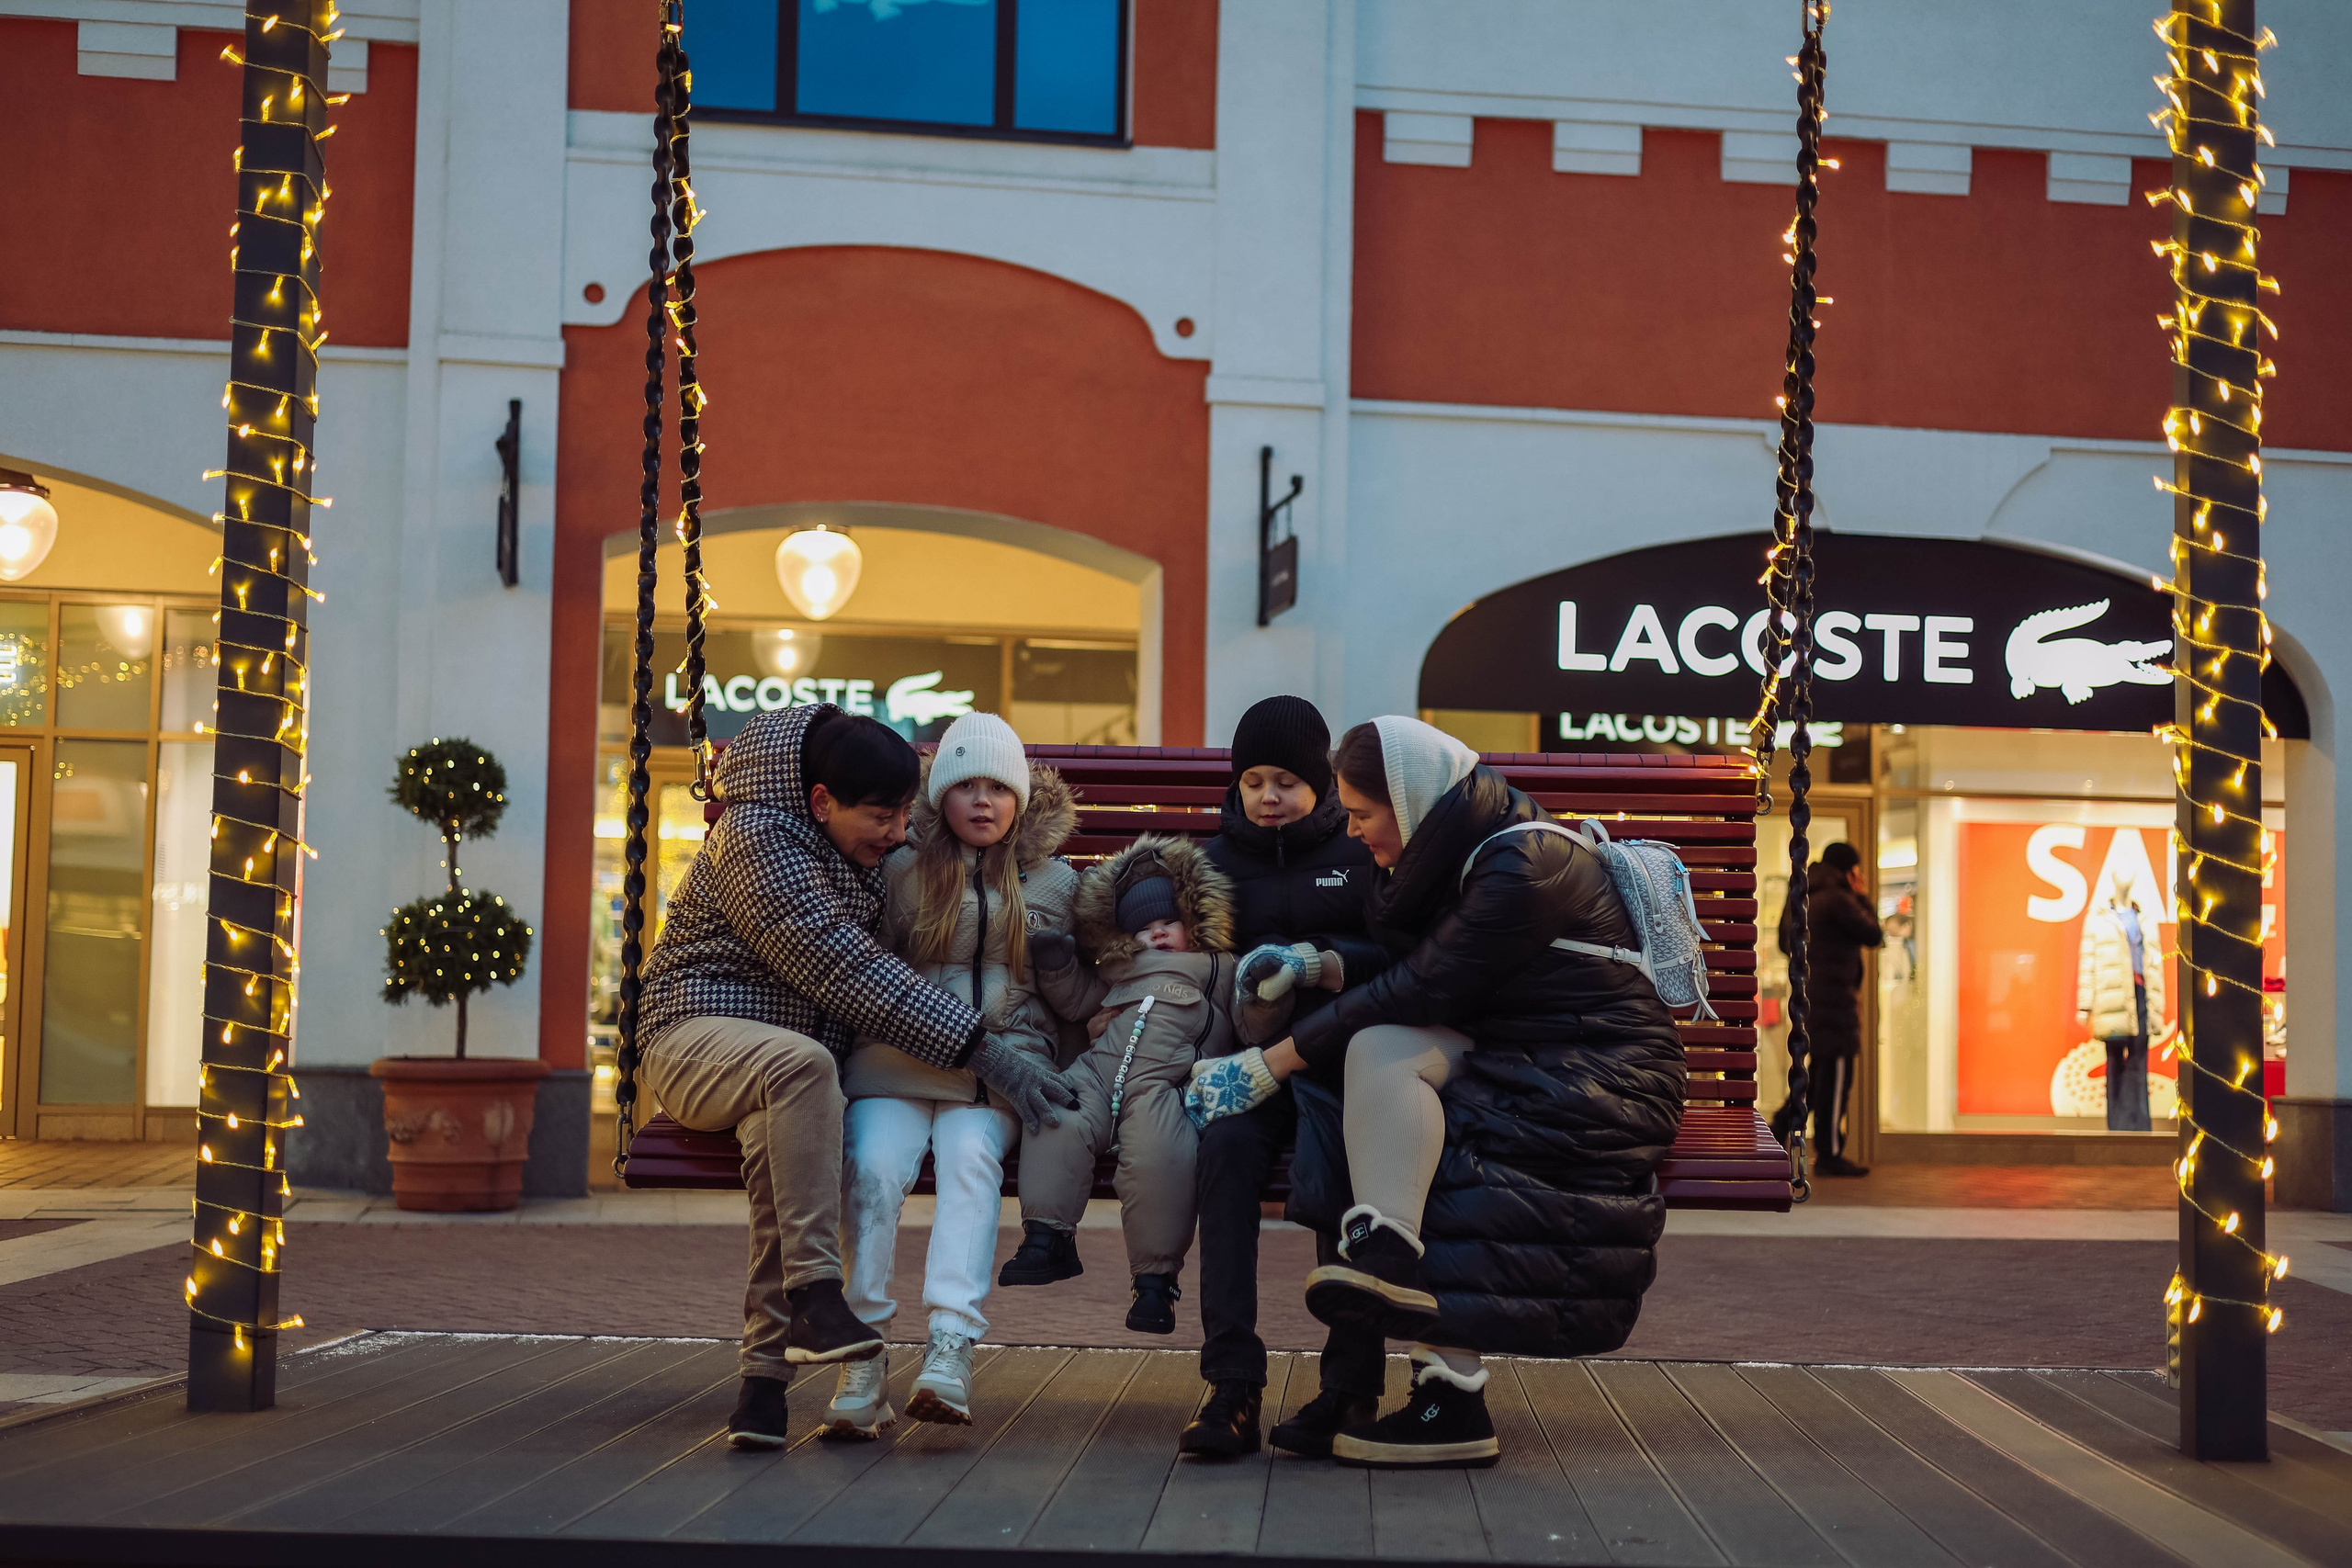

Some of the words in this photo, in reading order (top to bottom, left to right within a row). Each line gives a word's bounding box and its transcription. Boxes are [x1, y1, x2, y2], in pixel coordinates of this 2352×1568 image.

[1557, 600, 1975, 684] LACOSTE
[664, 671, 876, 716] LACOSTE
[1315, 877, 1343, 887] PUMA
[1162, 983, 1189, 999] Kids
